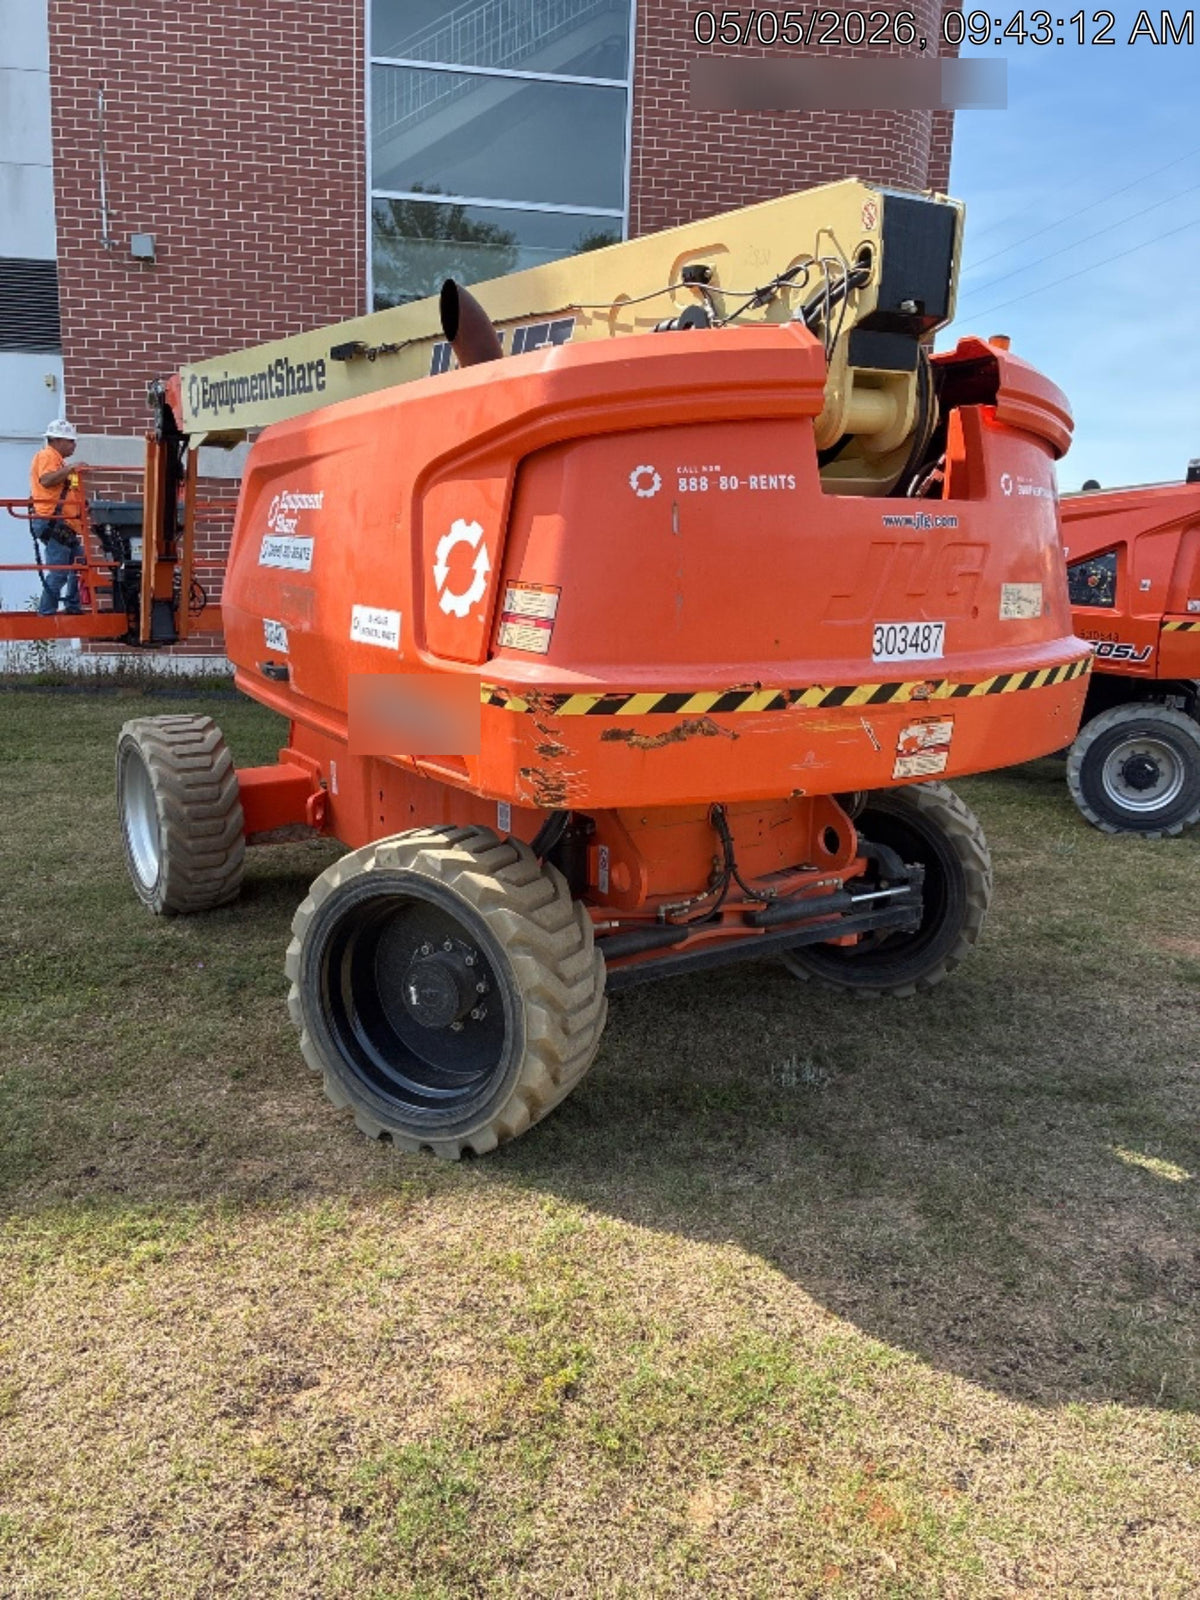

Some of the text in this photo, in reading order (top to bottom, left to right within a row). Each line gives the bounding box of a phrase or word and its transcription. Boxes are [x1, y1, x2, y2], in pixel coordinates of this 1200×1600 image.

[200, 357, 326, 416] EquipmentShare
[882, 512, 959, 531] www.jlg.com
[872, 623, 943, 657] 303487
